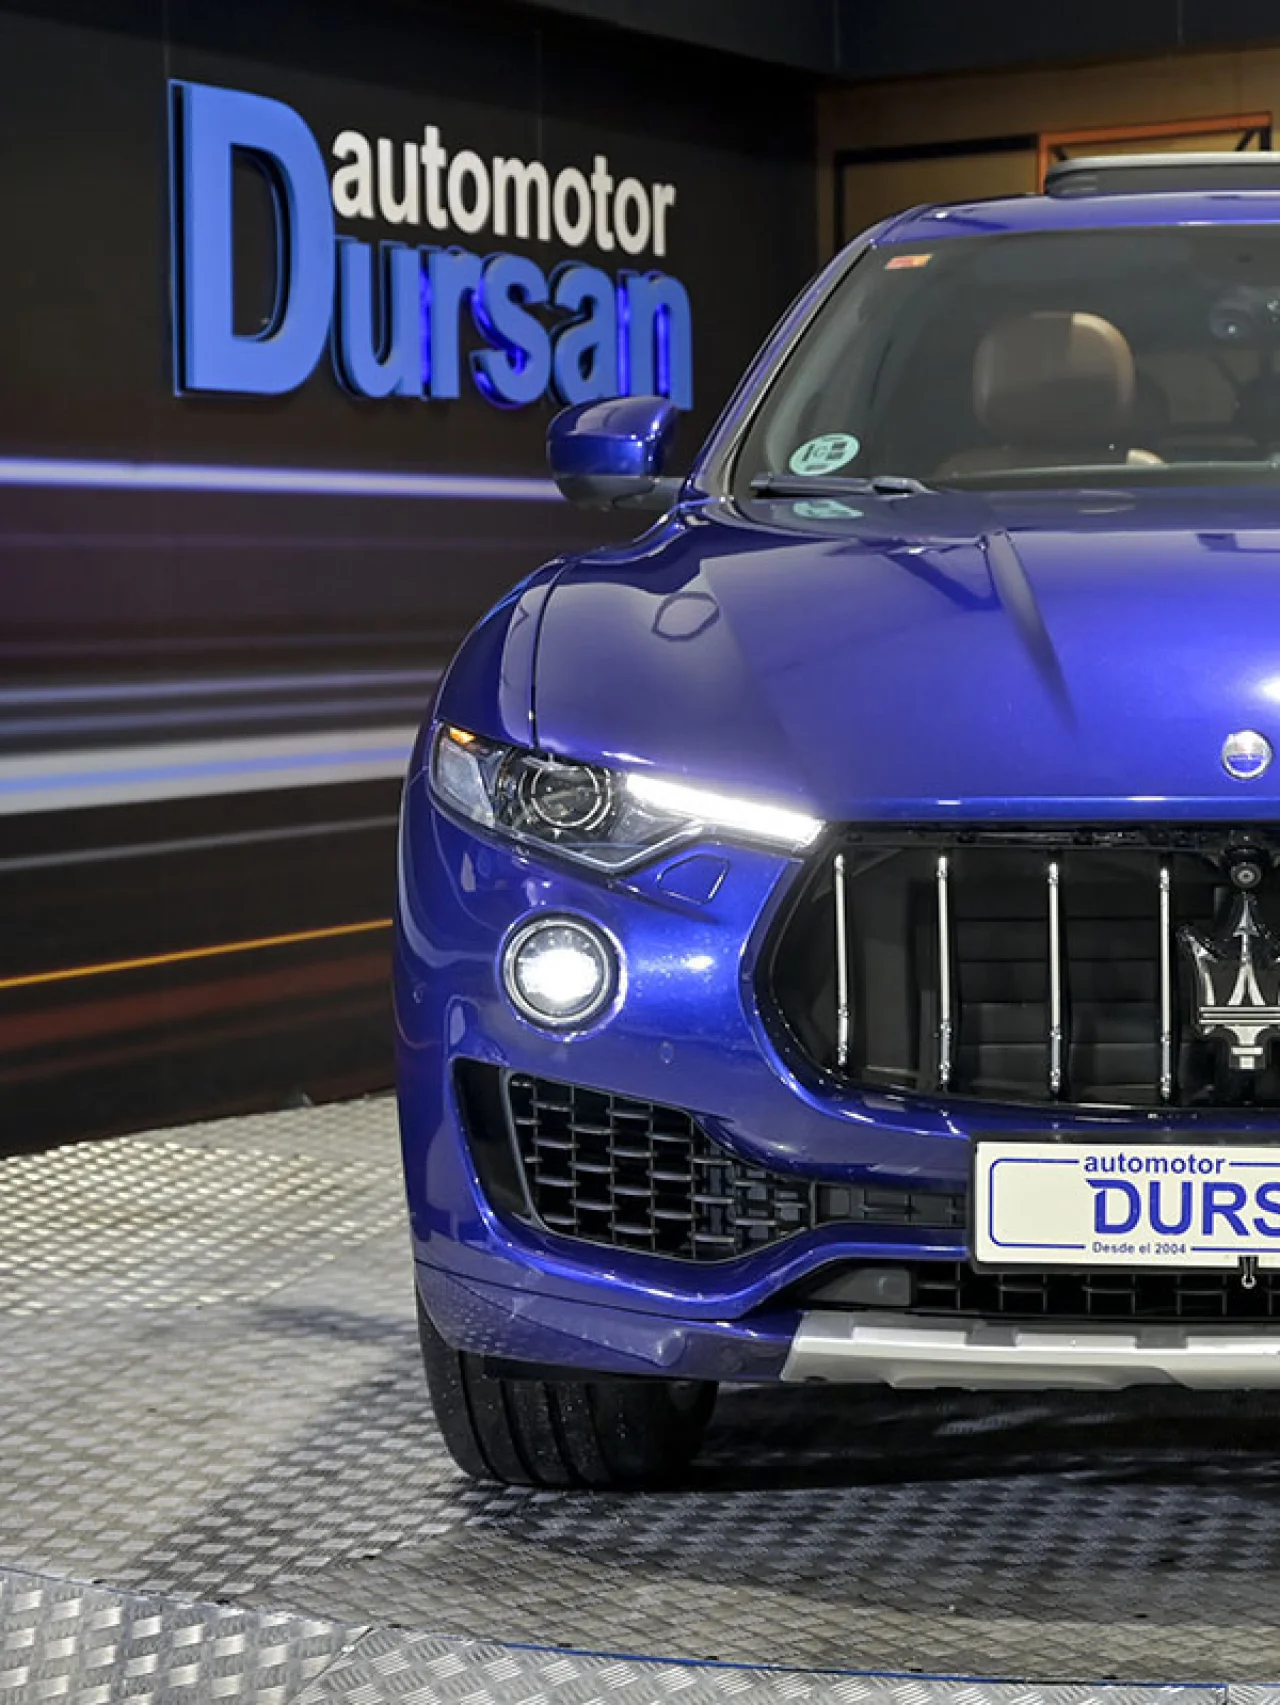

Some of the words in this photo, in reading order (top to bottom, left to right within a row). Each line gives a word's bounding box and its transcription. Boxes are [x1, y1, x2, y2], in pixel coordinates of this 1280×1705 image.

[331, 125, 677, 257] automotor
[168, 78, 694, 411] Dursan
[1083, 1152, 1226, 1175] automotor
[1092, 1241, 1136, 1254] Desde
[1138, 1242, 1151, 1254] el
[1155, 1242, 1187, 1255] 2004
